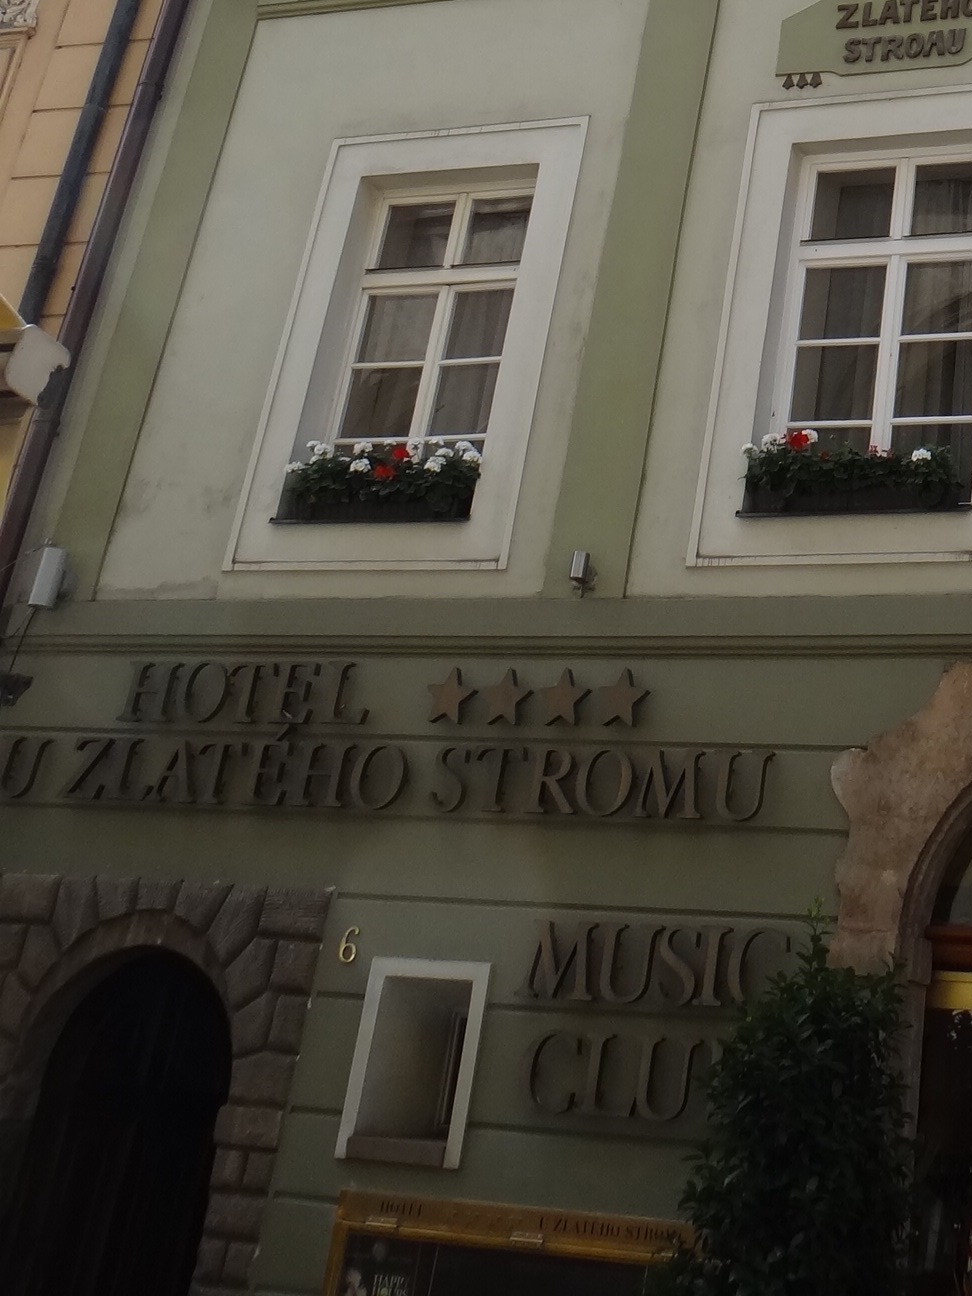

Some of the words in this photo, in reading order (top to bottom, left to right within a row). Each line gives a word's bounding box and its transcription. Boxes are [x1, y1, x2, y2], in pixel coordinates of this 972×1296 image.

[843, 28, 967, 64] STROMU
[115, 660, 369, 725] HOTEL
[0, 737, 53, 799] U
[60, 725, 409, 810] ZLATÉHO
[430, 747, 775, 821] STROMU
[337, 926, 361, 964] 6
[514, 919, 791, 1007] MUSIC
[519, 1028, 726, 1122] CLU
